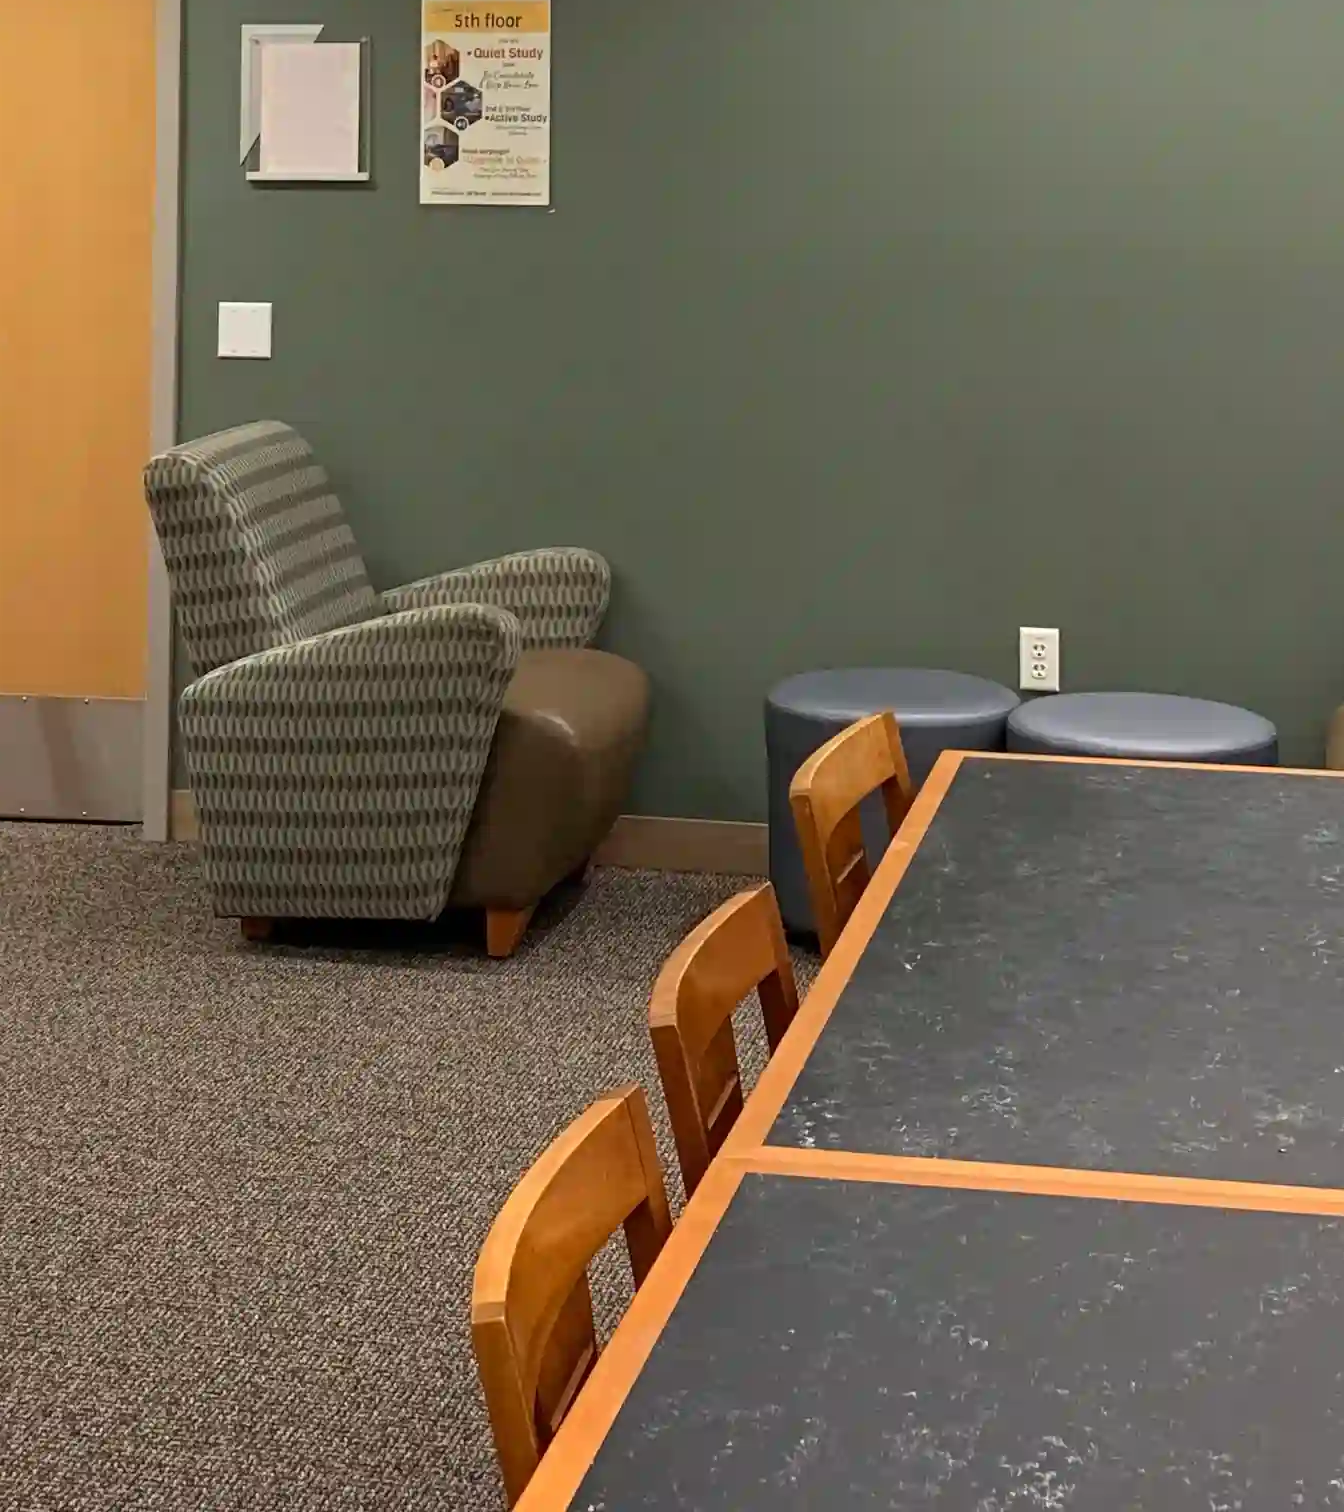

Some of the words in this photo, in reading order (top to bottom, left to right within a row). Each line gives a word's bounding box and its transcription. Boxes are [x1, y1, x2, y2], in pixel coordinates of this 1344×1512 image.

[454, 13, 480, 28] 5th
[484, 13, 523, 28] floor
[474, 47, 506, 59] Quiet
[509, 47, 544, 60] Study
[490, 114, 518, 123] Active
[521, 113, 547, 124] Study
